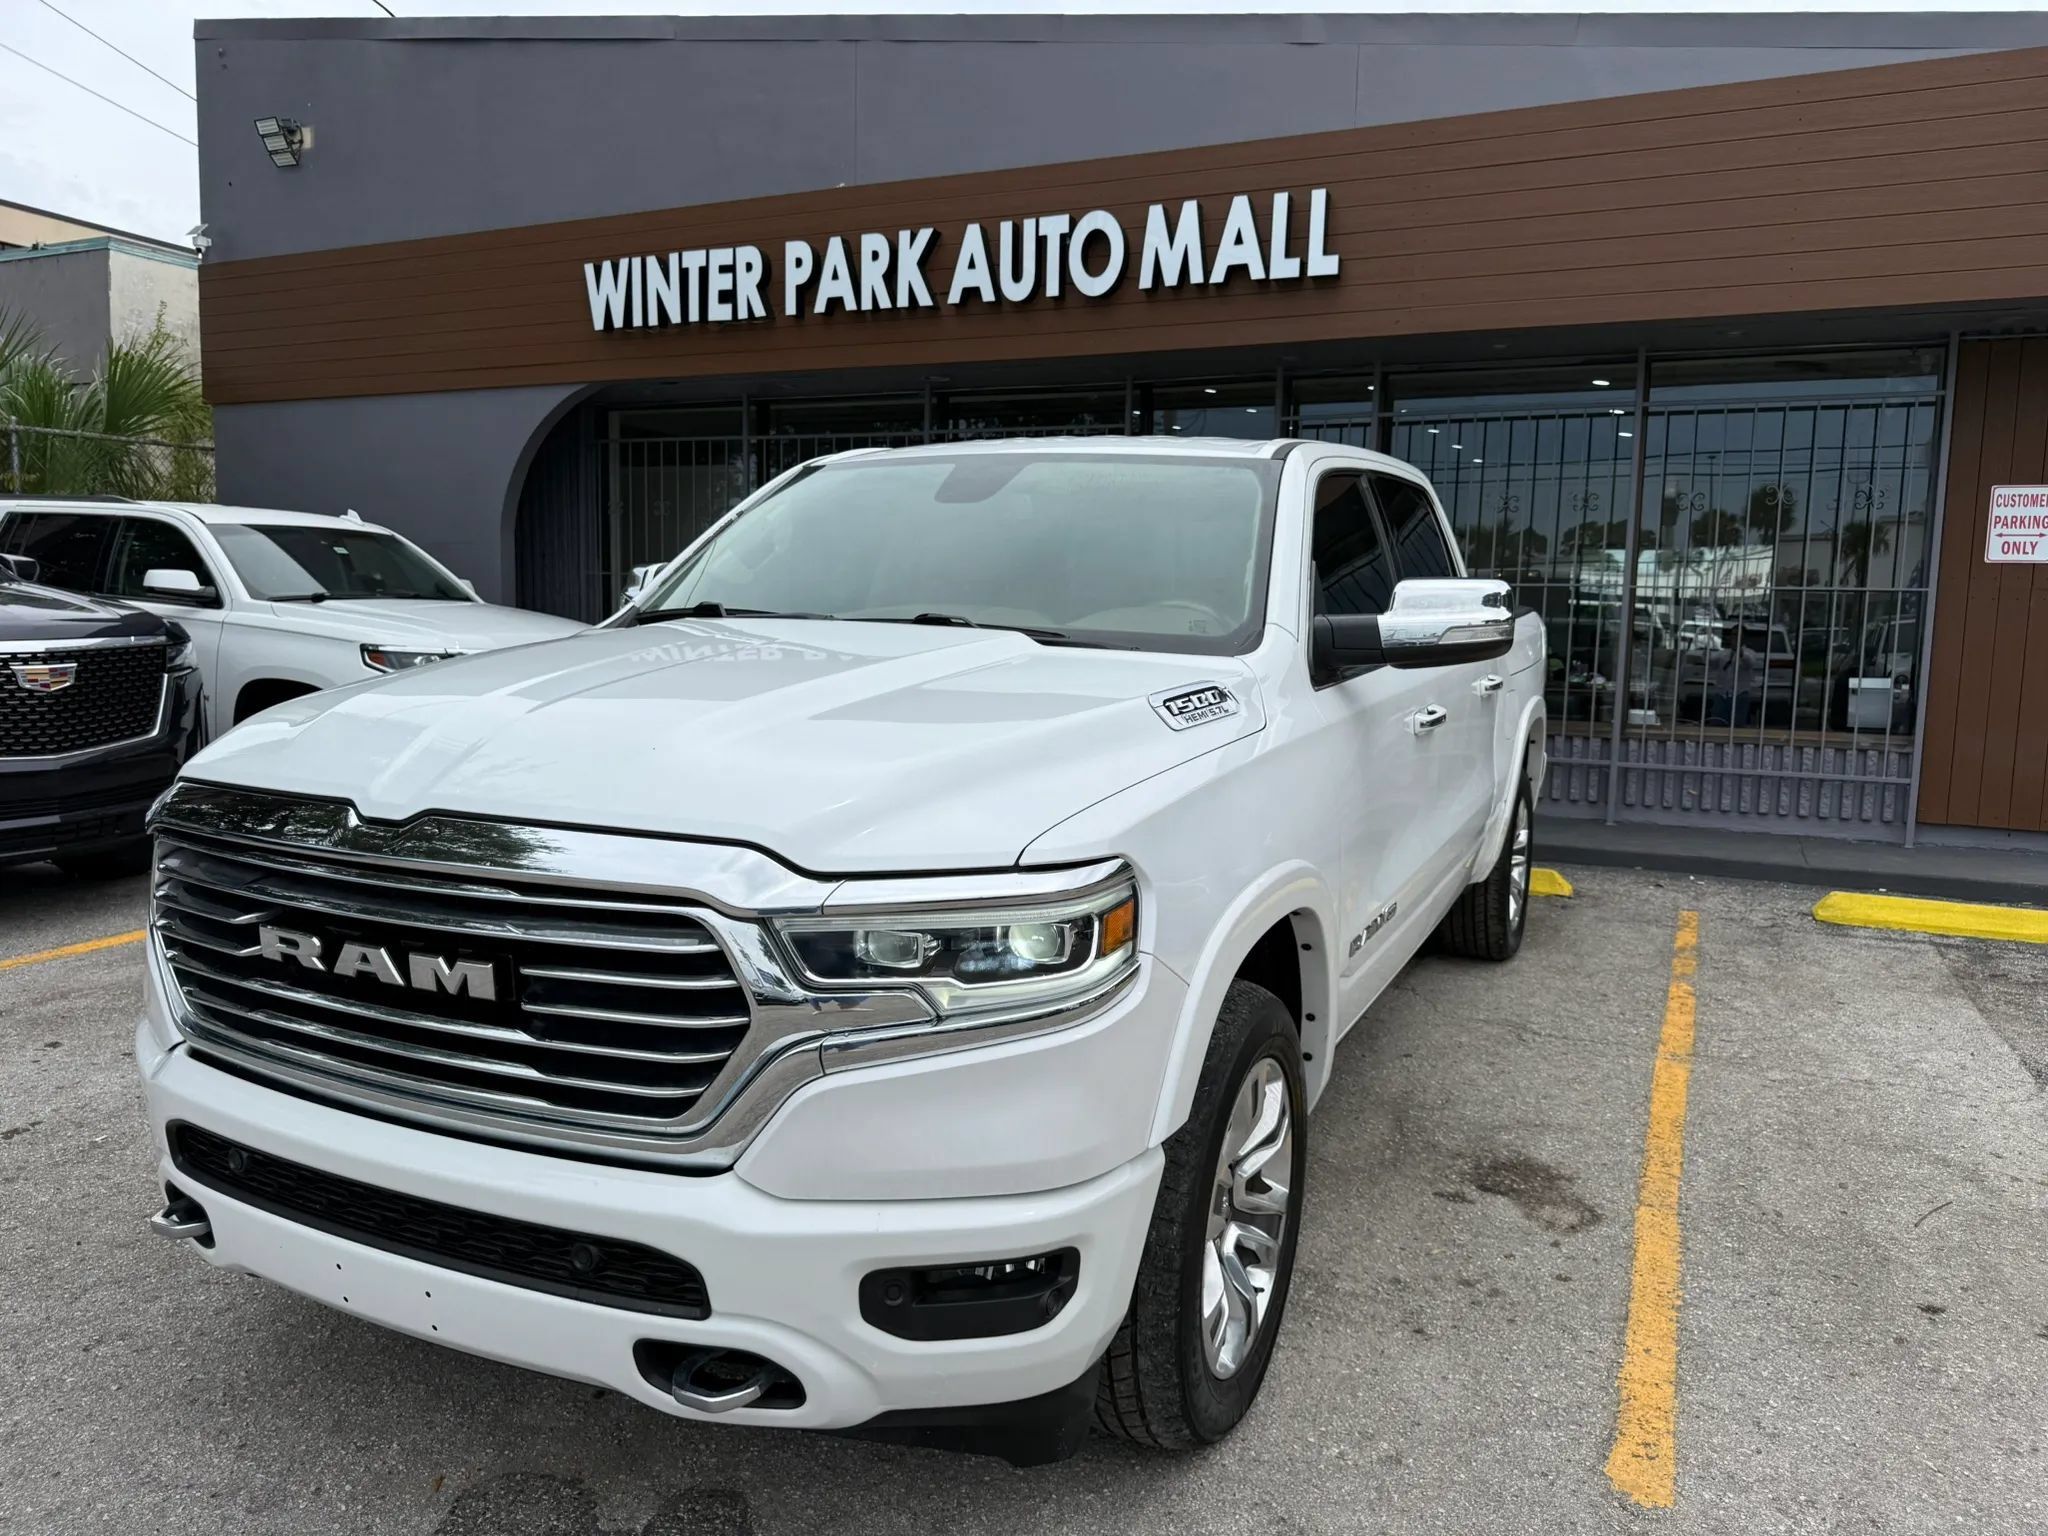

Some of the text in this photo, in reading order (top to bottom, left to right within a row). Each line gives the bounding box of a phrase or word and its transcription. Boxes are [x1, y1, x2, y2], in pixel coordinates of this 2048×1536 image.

[584, 187, 1341, 332] WINTER PARK AUTO MALL
[1993, 515, 2048, 529] PARKING
[2001, 541, 2038, 555] ONLY
[1164, 690, 1222, 716] 1500
[1183, 704, 1229, 724] HEMI 5.7L
[259, 924, 496, 1001] RAM
